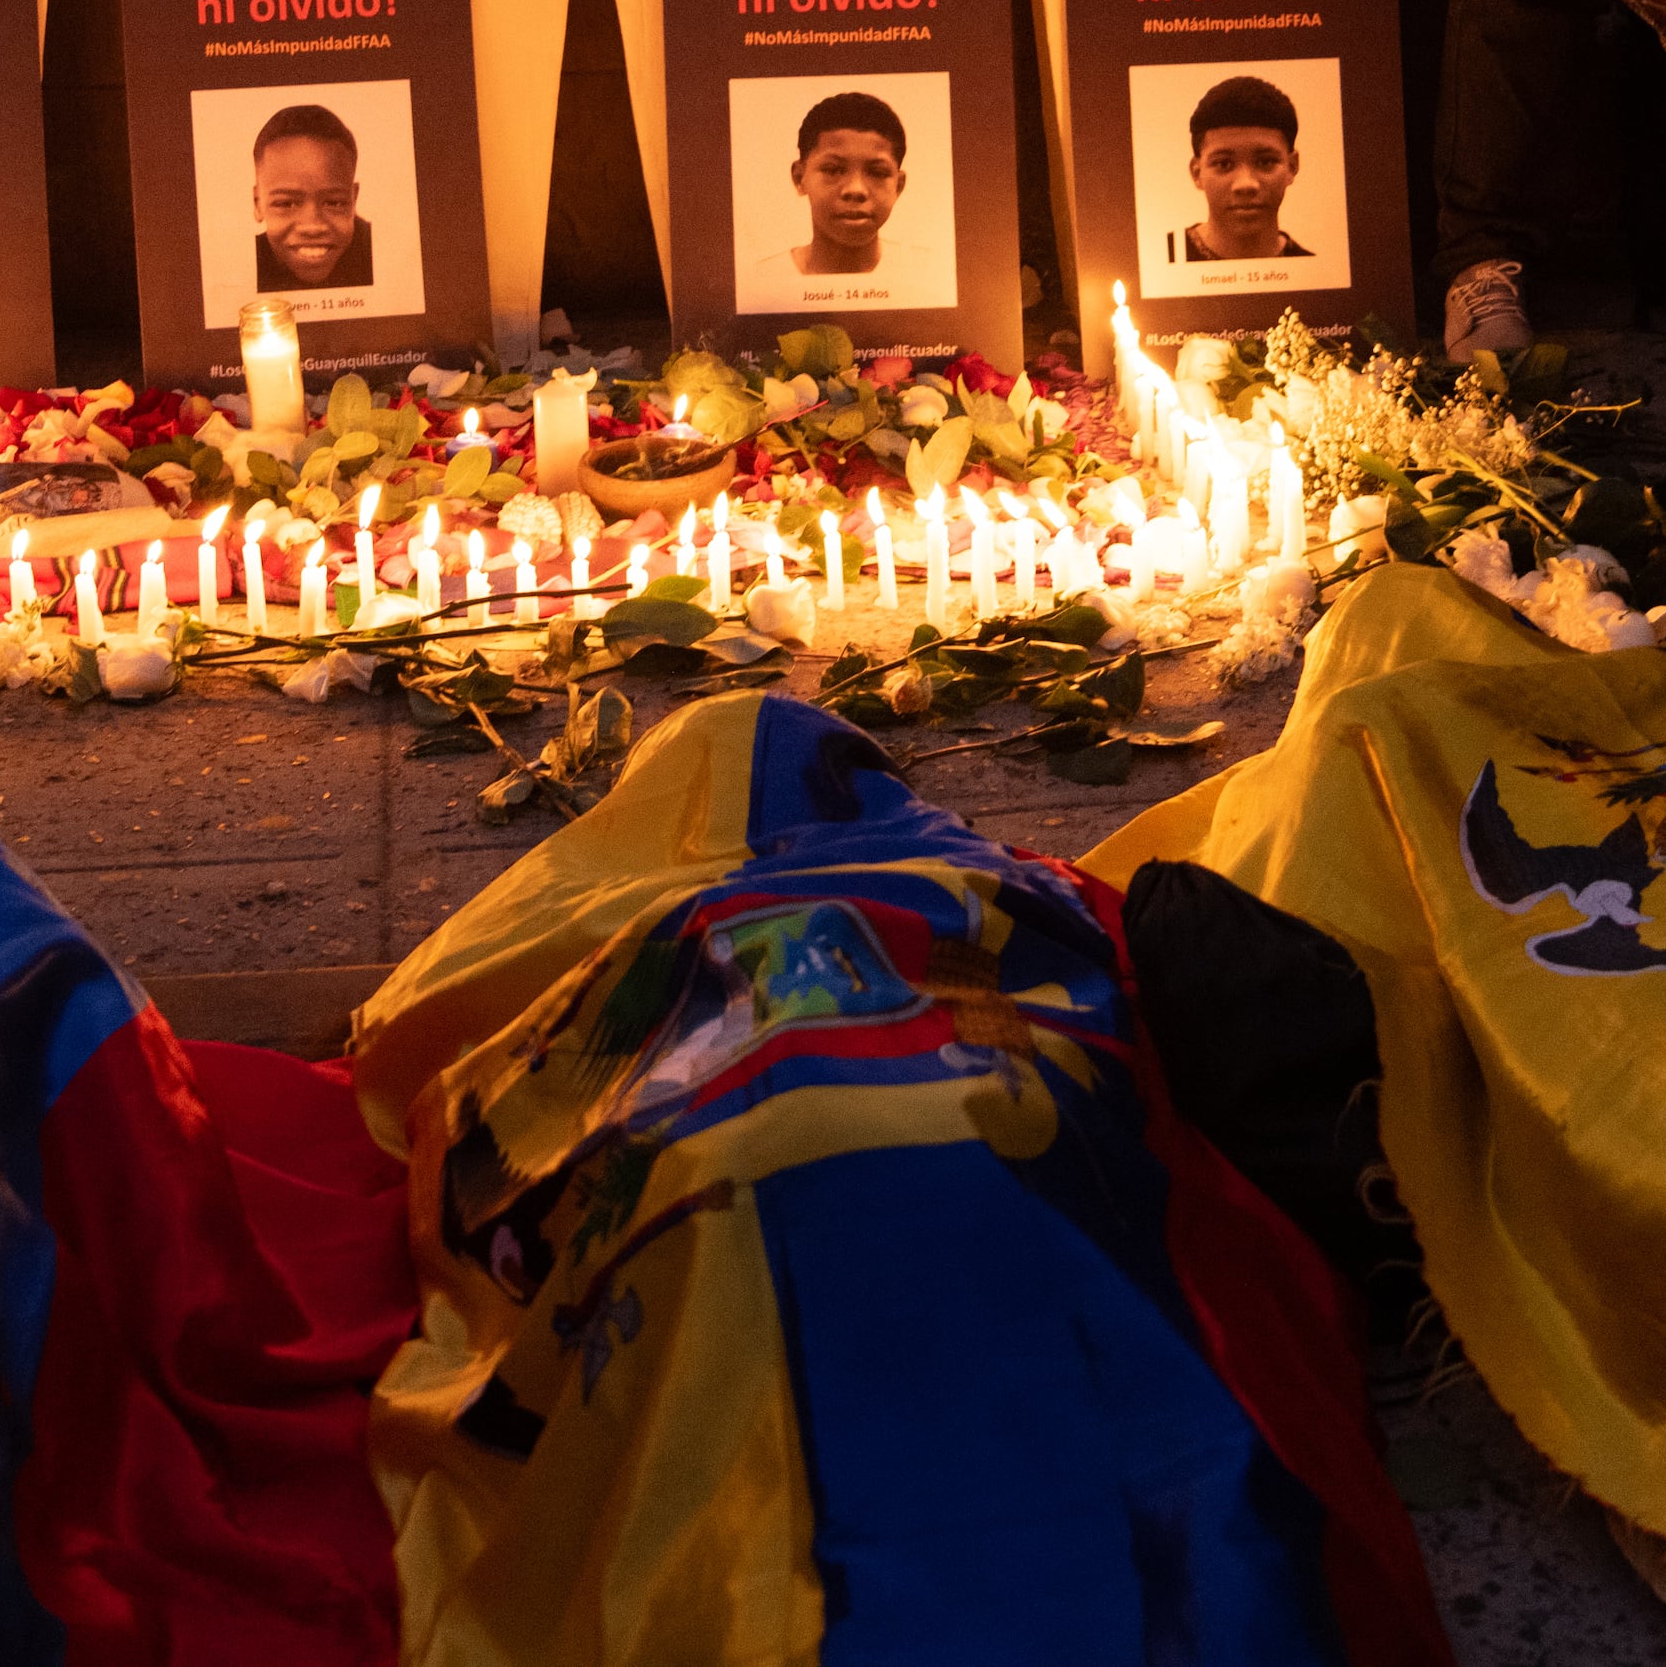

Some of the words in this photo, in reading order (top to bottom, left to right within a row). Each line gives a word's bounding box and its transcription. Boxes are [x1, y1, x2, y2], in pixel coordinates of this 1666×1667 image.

[1143, 13, 1322, 34] #NoMásImpunidadFFAA
[204, 34, 392, 57] #NoMásImpunidadFFAA
[744, 26, 932, 47] #NoMásImpunidadFFAA
[1201, 272, 1237, 285] Ismael
[1262, 270, 1289, 281] años
[321, 300, 334, 310] 11
[337, 298, 365, 308] años
[845, 289, 859, 300] 14
[862, 288, 889, 299] años
[209, 350, 427, 379] #LosGuayaquilEcuador
